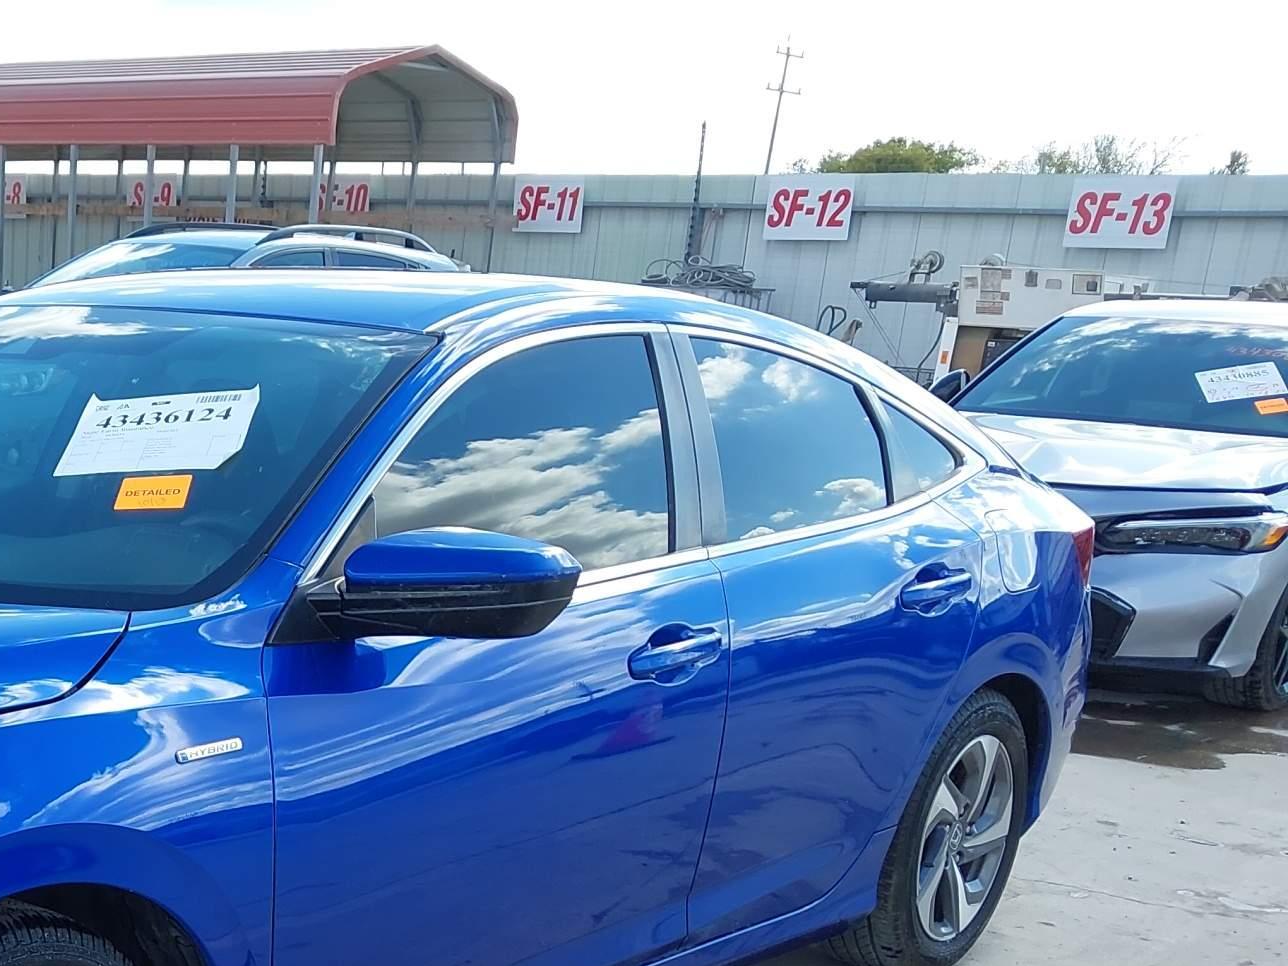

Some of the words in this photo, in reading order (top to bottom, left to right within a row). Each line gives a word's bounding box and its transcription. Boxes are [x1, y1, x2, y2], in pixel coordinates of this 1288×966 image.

[131, 182, 172, 207] S-9
[517, 185, 581, 221] SF-11
[767, 188, 852, 228] SF-12
[1069, 191, 1172, 236] SF-13
[96, 406, 232, 429] 43436124
[125, 488, 181, 497] DETAILED
[189, 741, 238, 758] HYBRID
